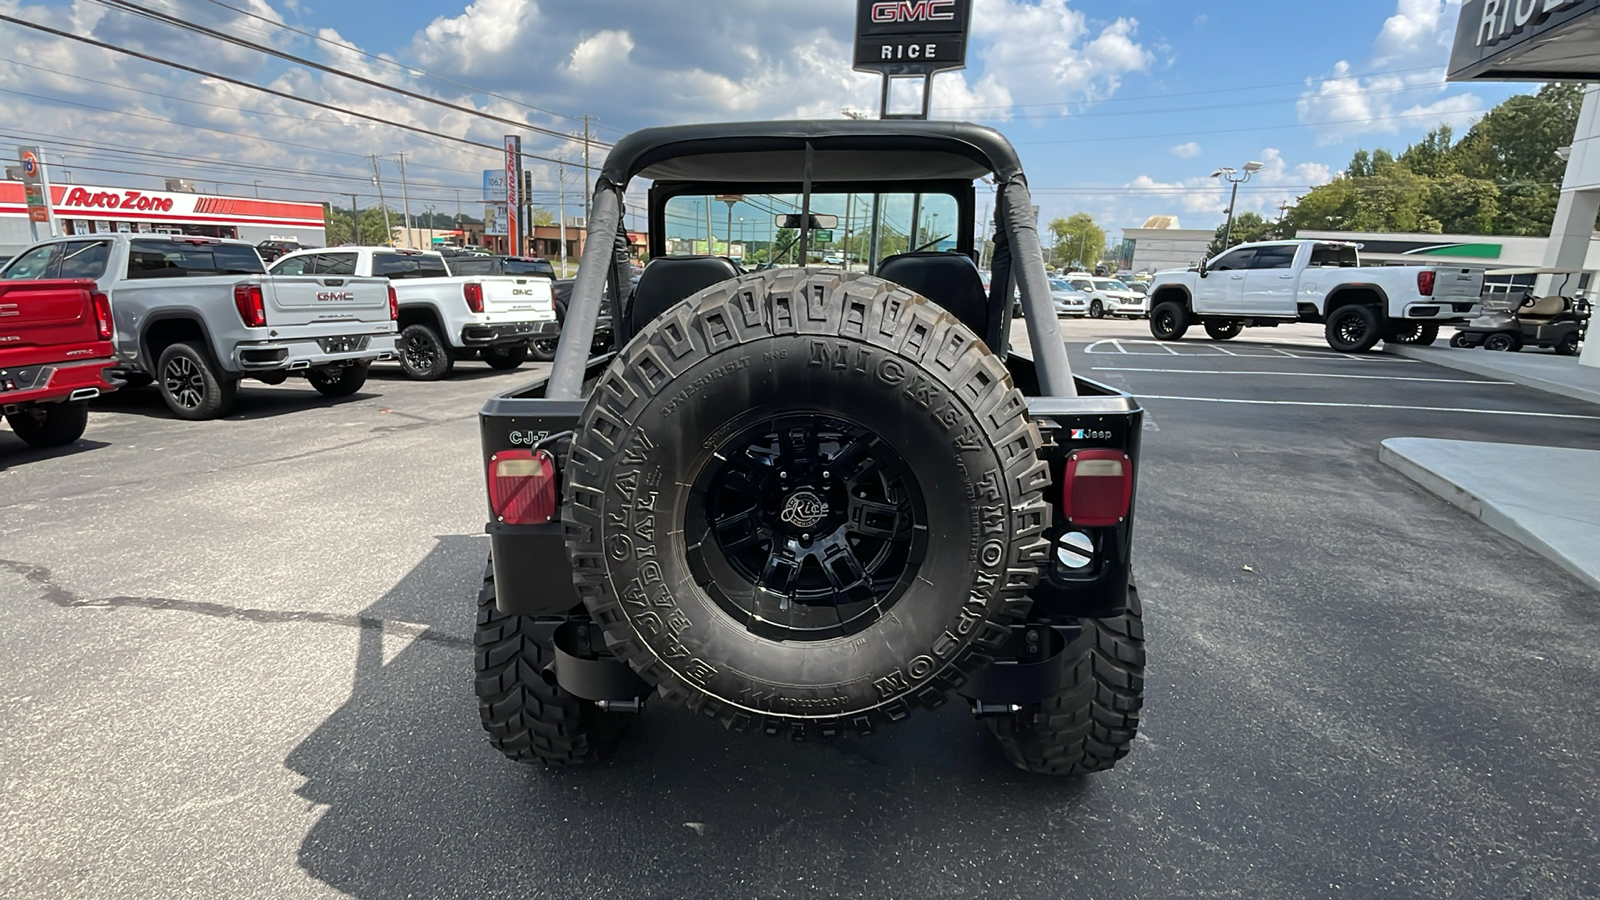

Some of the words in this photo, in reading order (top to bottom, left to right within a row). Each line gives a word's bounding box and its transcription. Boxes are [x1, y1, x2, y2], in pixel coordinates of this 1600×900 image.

[871, 0, 955, 22] GMC
[1476, 0, 1565, 47] RI
[881, 44, 937, 59] RICE
[317, 292, 354, 301] GMC
[808, 340, 984, 452] MICKEY
[1085, 429, 1112, 439] Jeep
[606, 425, 654, 561] CLAW
[781, 499, 829, 522] Rice
[635, 491, 693, 635] RADIAL
[873, 469, 1006, 698] THOMPSON
